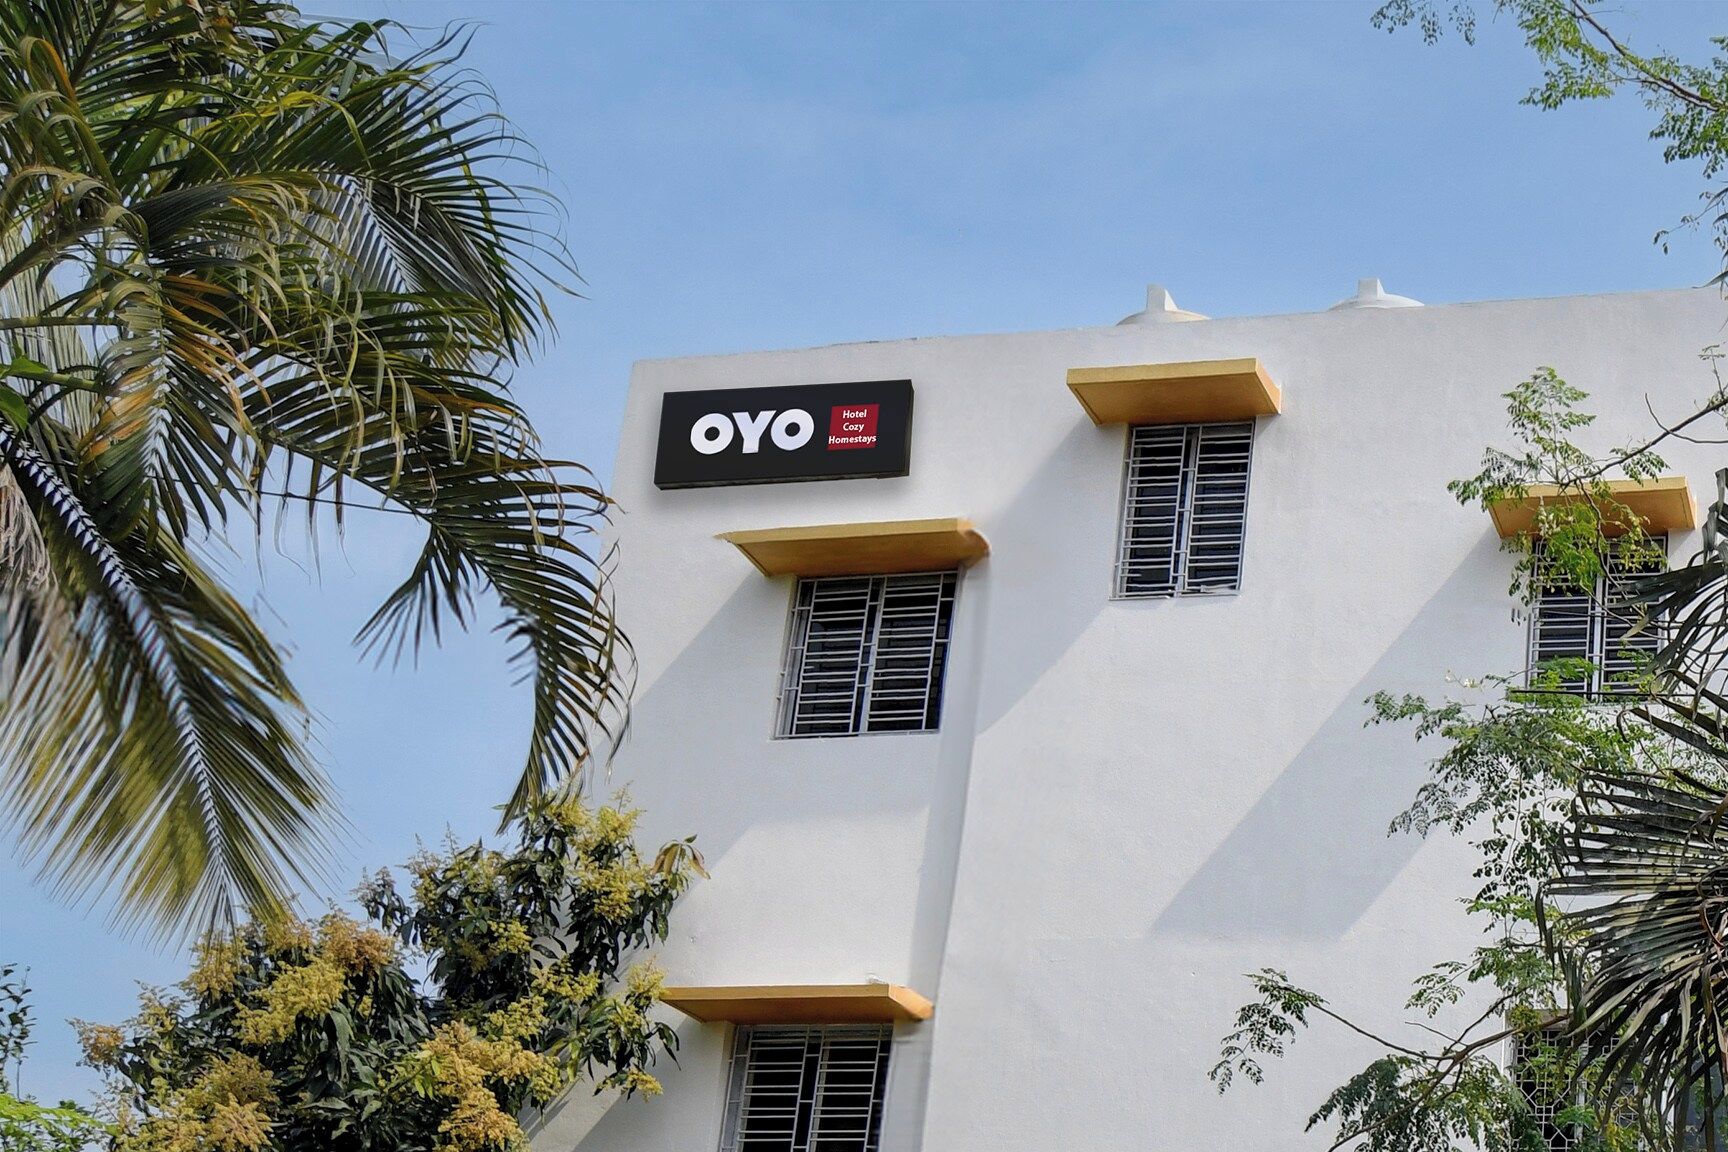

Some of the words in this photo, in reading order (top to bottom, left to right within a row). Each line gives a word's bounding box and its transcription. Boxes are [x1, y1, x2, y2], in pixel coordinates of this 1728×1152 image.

[842, 409, 867, 419] Hotel
[690, 408, 815, 455] OYO
[842, 422, 865, 433] Cozy
[828, 435, 877, 445] Homestays
